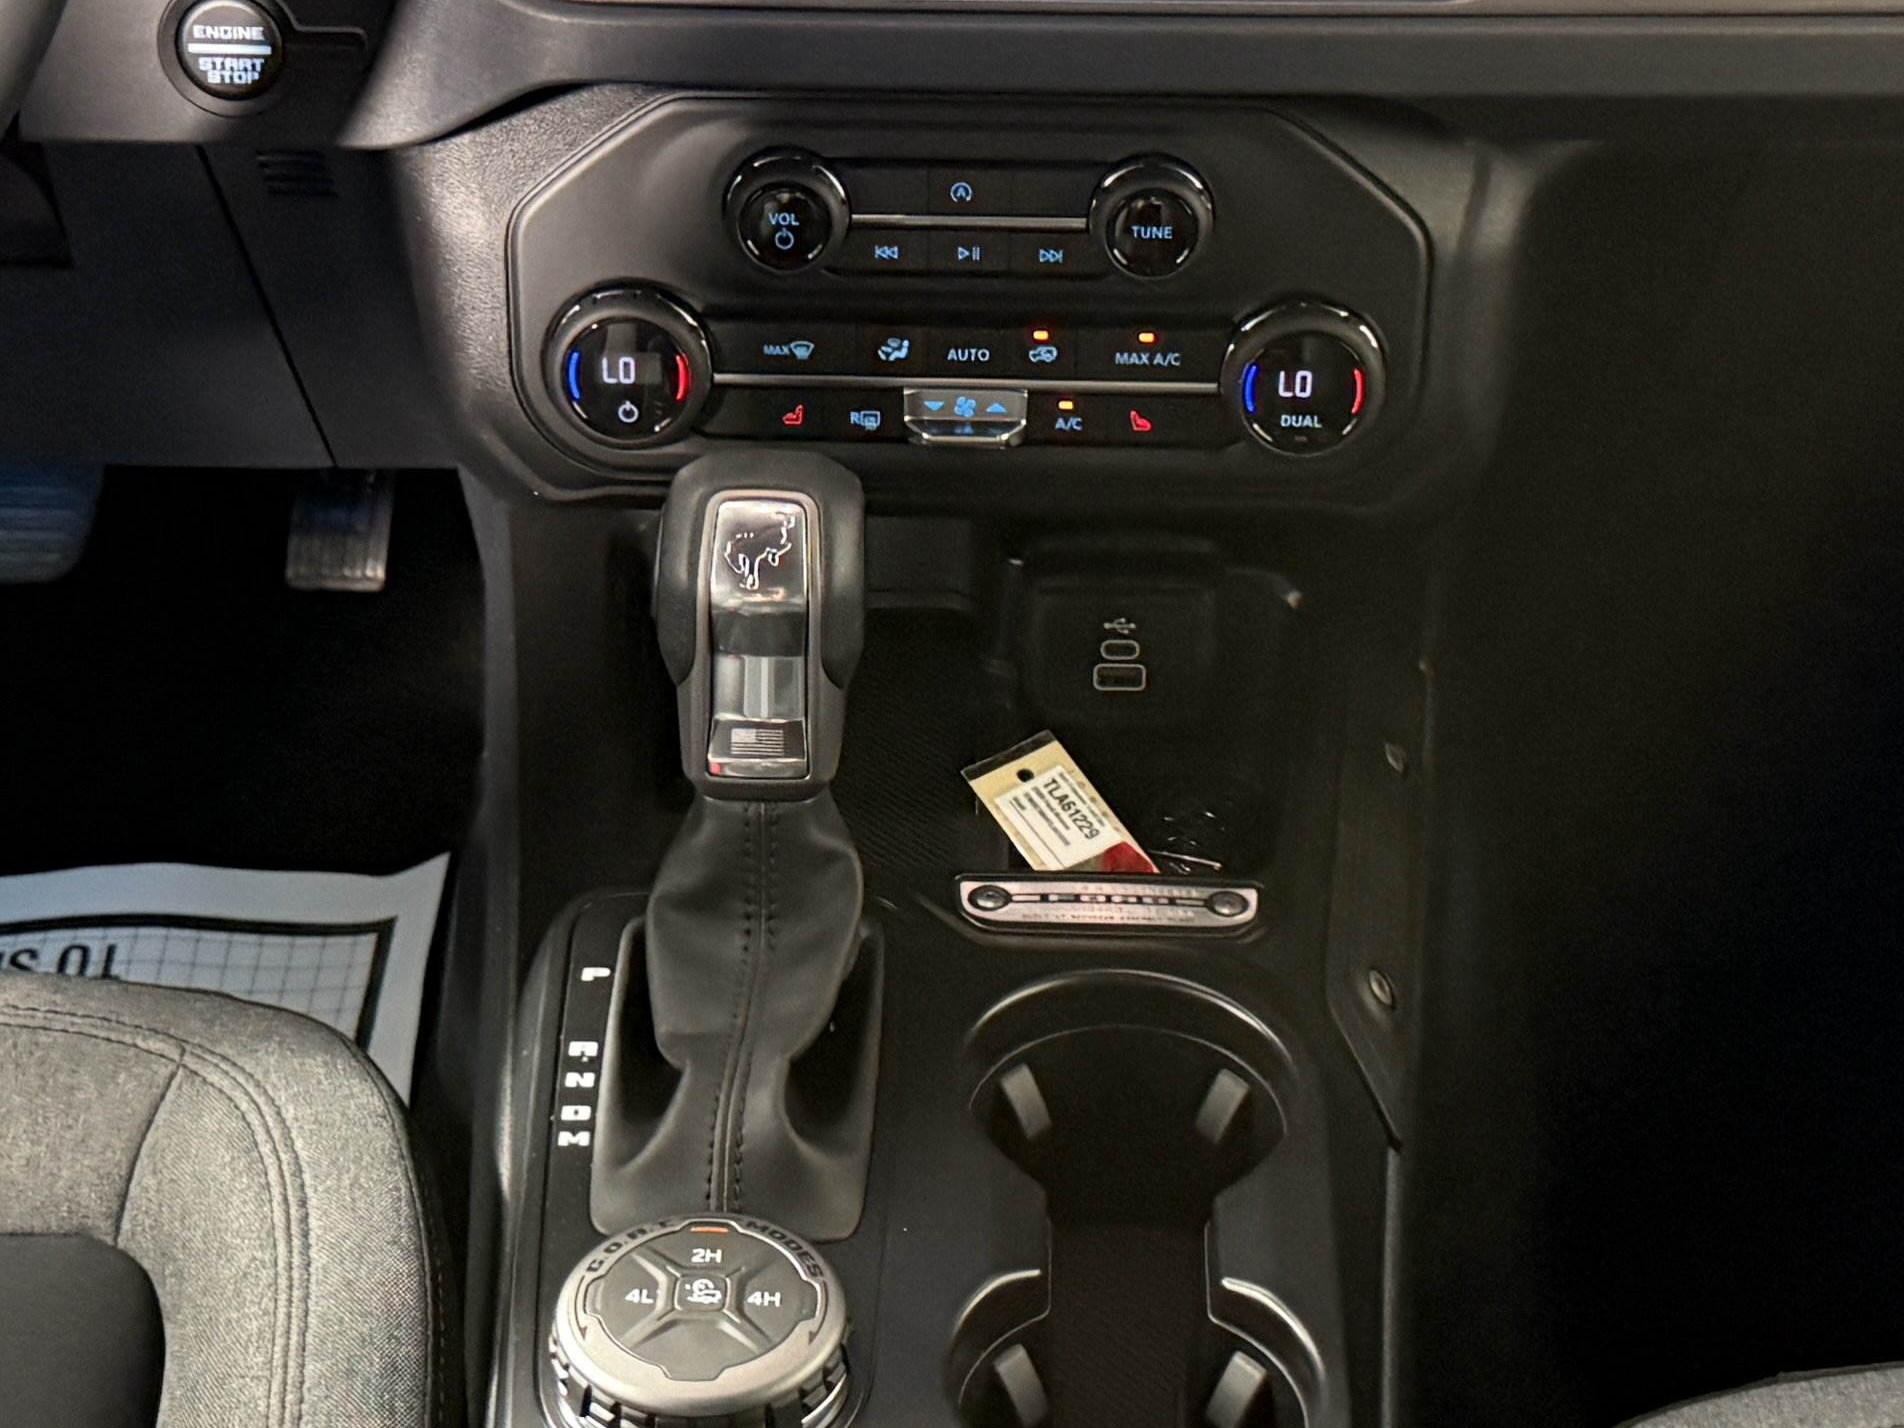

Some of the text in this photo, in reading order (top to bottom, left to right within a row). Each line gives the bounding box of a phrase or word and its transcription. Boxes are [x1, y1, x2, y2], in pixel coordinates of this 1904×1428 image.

[192, 24, 266, 41] ENGINE
[198, 56, 265, 72] START
[206, 70, 261, 85] STOP
[768, 213, 800, 227] VOL
[1130, 225, 1174, 240] TUNE
[763, 344, 791, 356] MAX
[947, 348, 991, 362] AUTO
[1115, 352, 1182, 366] MAX A/C
[602, 357, 636, 385] LO
[1278, 370, 1313, 398] LO
[1055, 417, 1083, 432] A/C
[1280, 415, 1322, 428] DUAL
[1043, 777, 1101, 840] TLA61229
[580, 966, 612, 981] P
[568, 1040, 599, 1057] R
[564, 1072, 596, 1088] N
[560, 1104, 592, 1121] D
[557, 1130, 591, 1147] M
[691, 1248, 722, 1263] 2H
[744, 1220, 825, 1278] MODES
[625, 1289, 655, 1305] 4L
[746, 1291, 782, 1307] 4H
